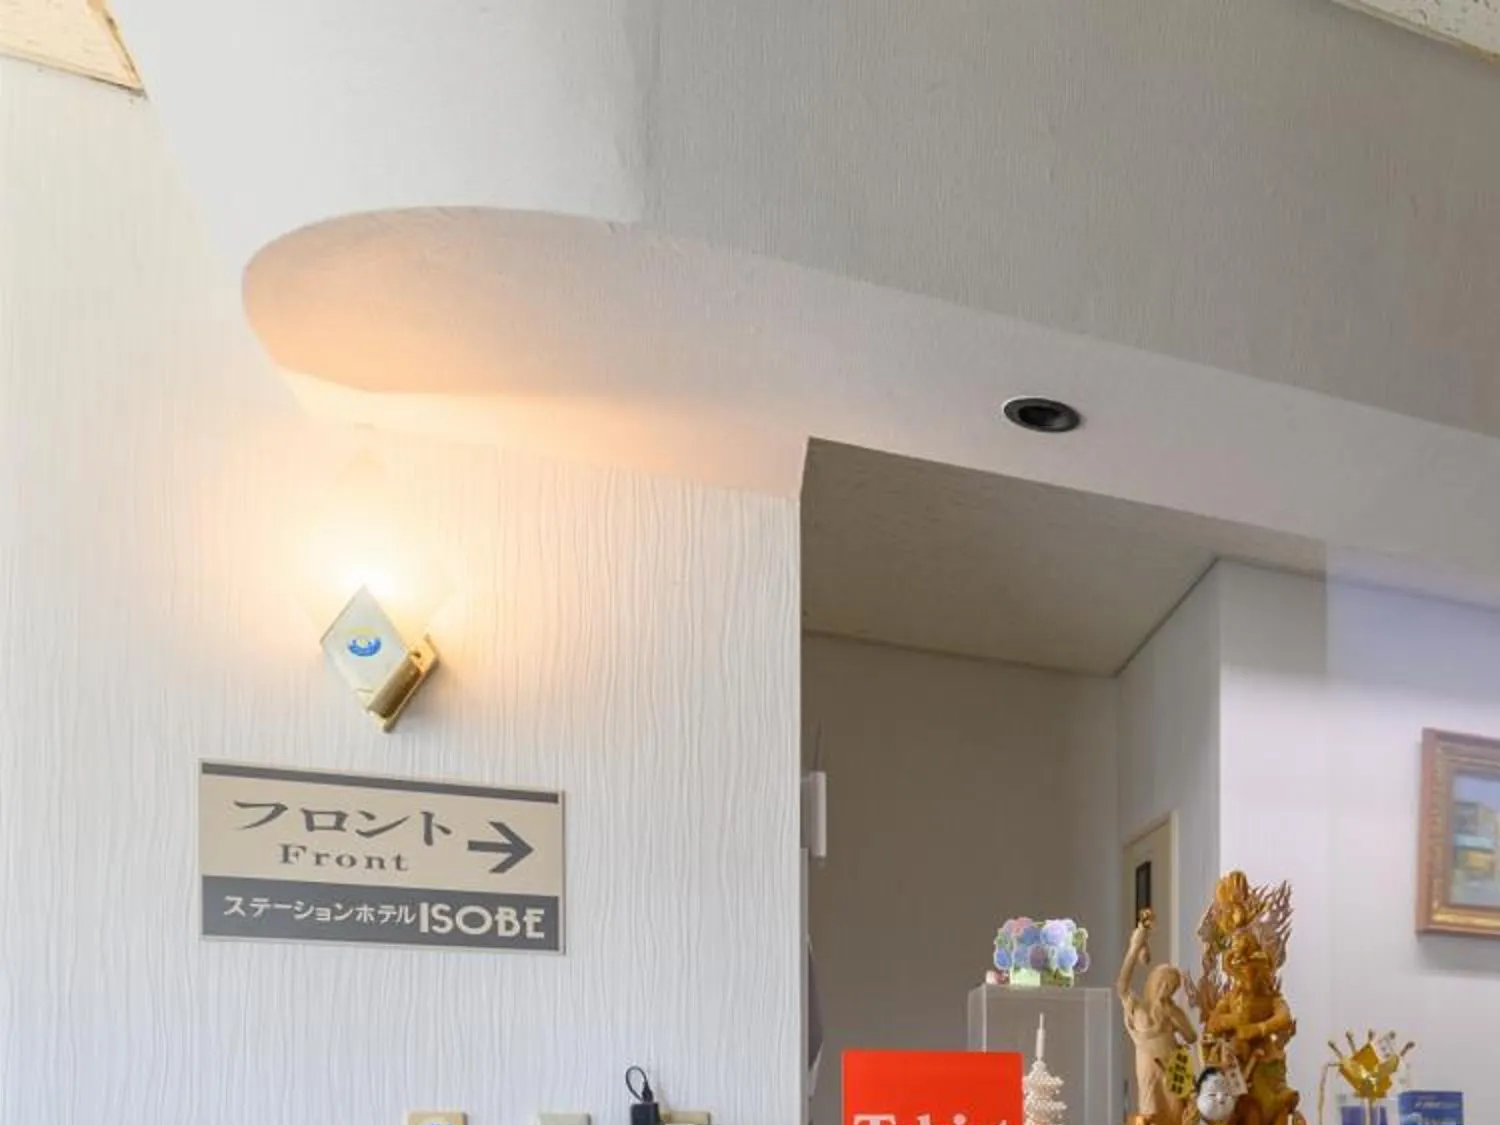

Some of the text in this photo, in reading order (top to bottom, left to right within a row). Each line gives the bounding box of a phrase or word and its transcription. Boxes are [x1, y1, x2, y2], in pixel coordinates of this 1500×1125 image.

[233, 799, 453, 846] フロント
[279, 843, 409, 872] Front
[223, 895, 546, 939] ステーションホテル ISOBE
